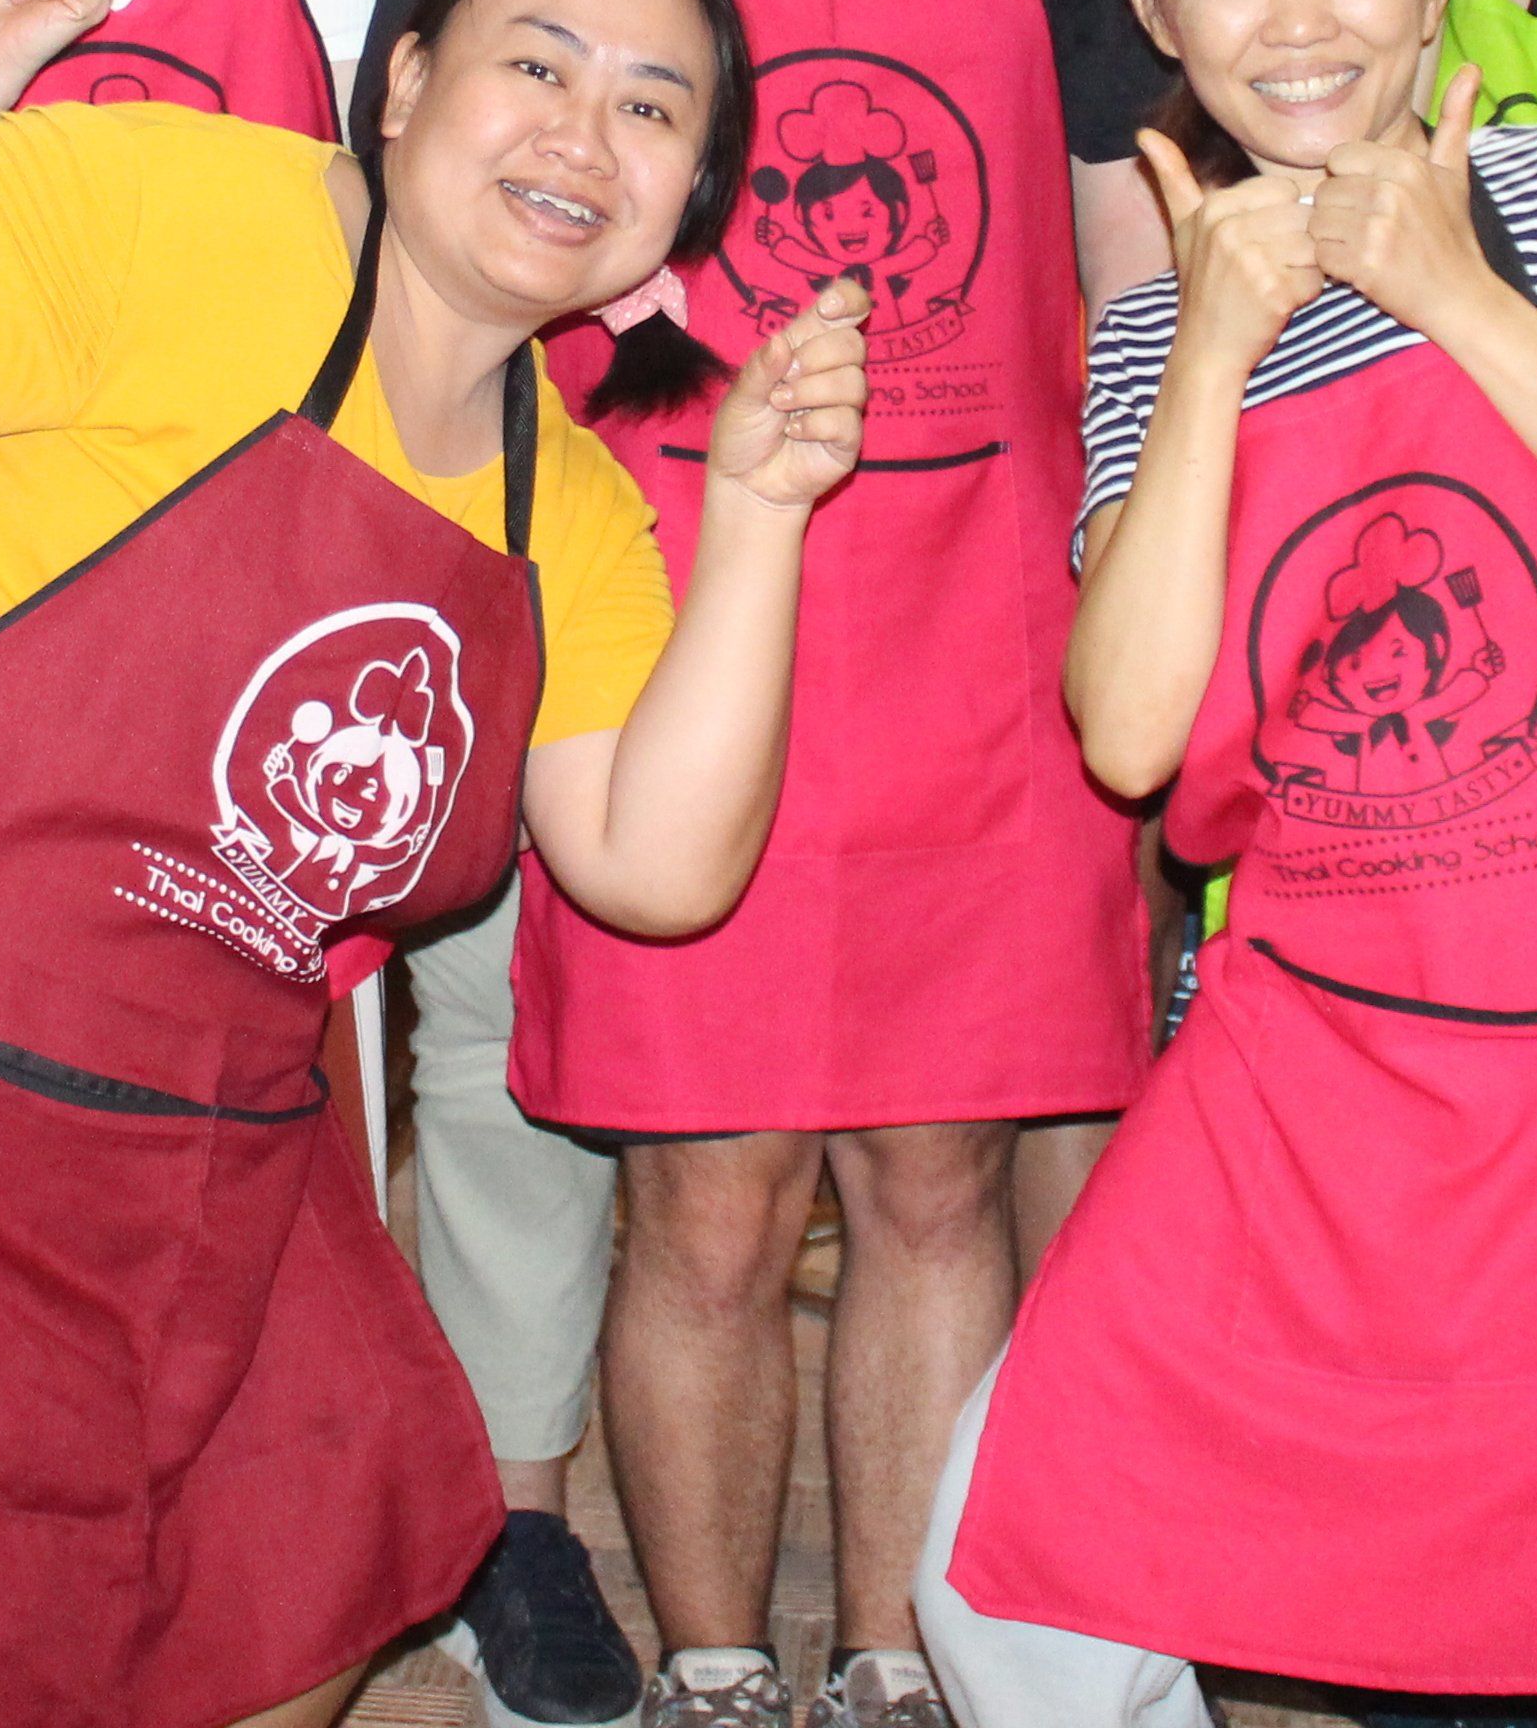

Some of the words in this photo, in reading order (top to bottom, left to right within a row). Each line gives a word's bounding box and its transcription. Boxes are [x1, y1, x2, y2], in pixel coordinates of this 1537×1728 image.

[884, 322, 948, 357] TASTY
[917, 378, 987, 400] School
[1305, 793, 1415, 826] YUMMY
[1430, 765, 1513, 819] TASTY
[231, 853, 308, 922] YUMMY
[1272, 863, 1331, 883] Thai
[1337, 850, 1462, 878] Cooking
[147, 865, 205, 913] Thai
[211, 902, 298, 972] Cooking
